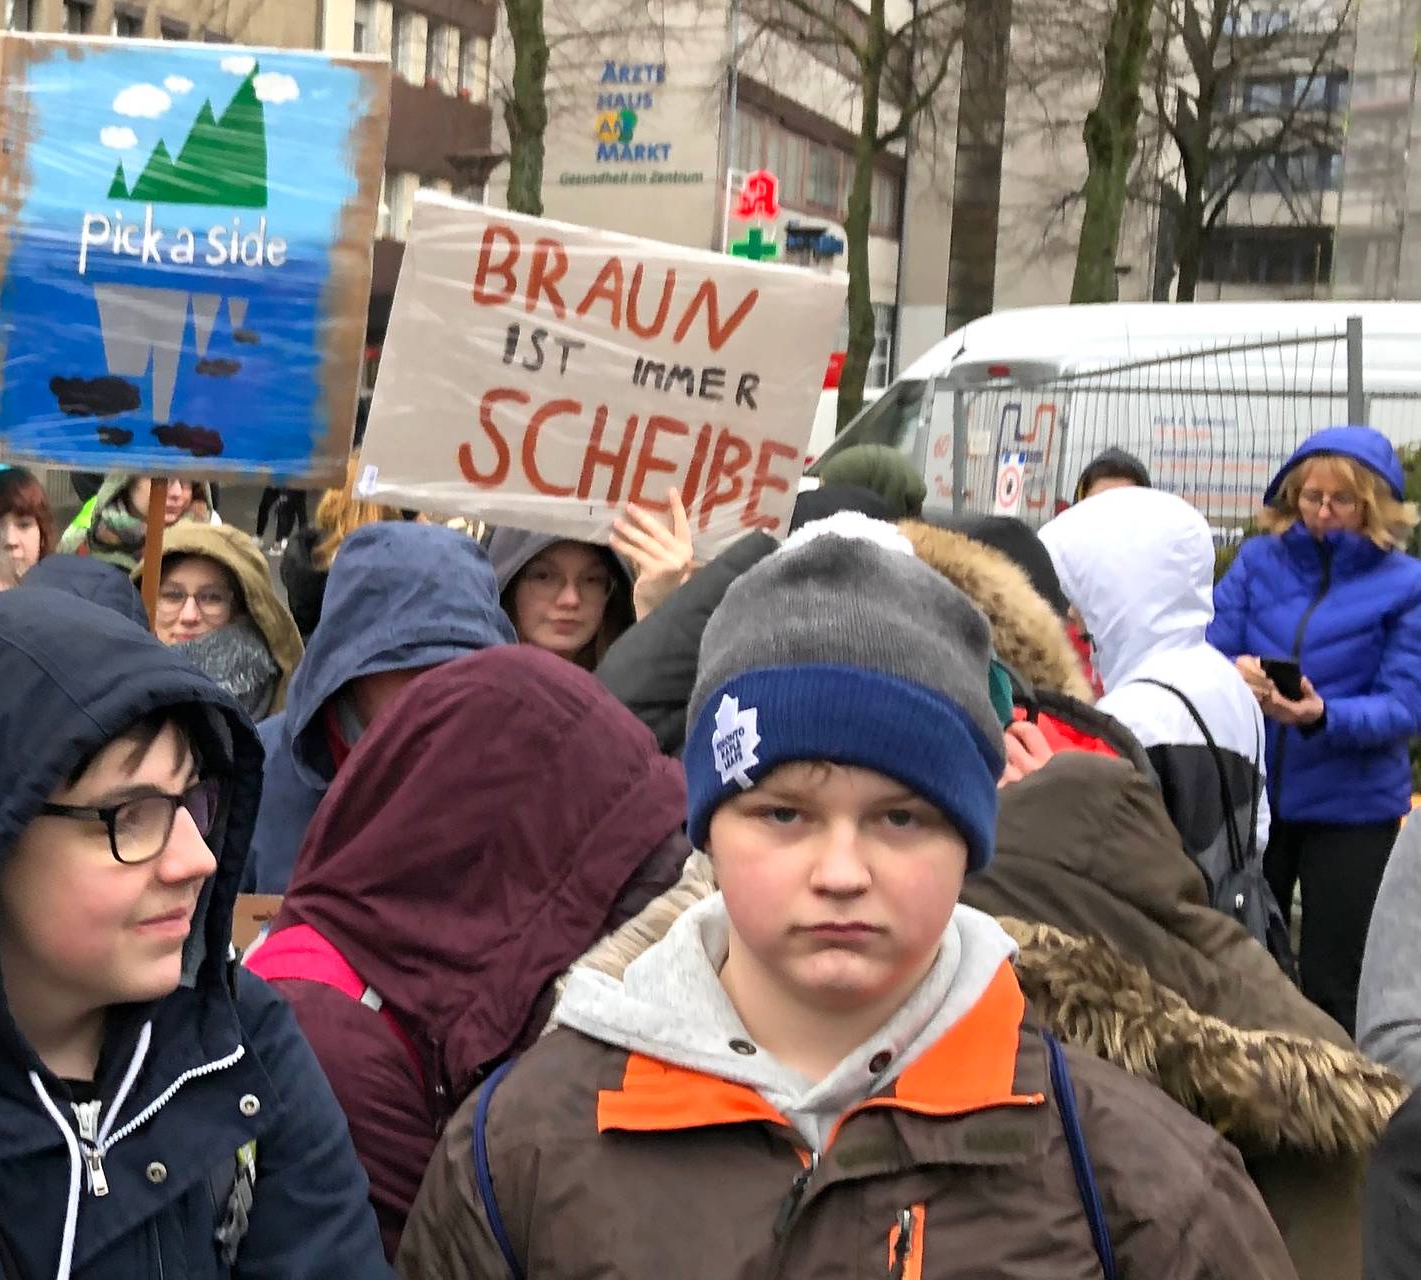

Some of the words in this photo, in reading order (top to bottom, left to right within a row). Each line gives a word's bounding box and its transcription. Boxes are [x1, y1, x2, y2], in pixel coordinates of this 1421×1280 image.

[596, 92, 652, 111] HAUS
[596, 142, 672, 163] MARKT
[560, 171, 628, 186] Gesundheit
[631, 172, 647, 185] im
[650, 170, 704, 185] Zentrum
[170, 227, 194, 264] a
[205, 215, 287, 267] side
[472, 224, 760, 352] BRAUN
[502, 323, 585, 376] IST
[632, 356, 760, 411] IMMER
